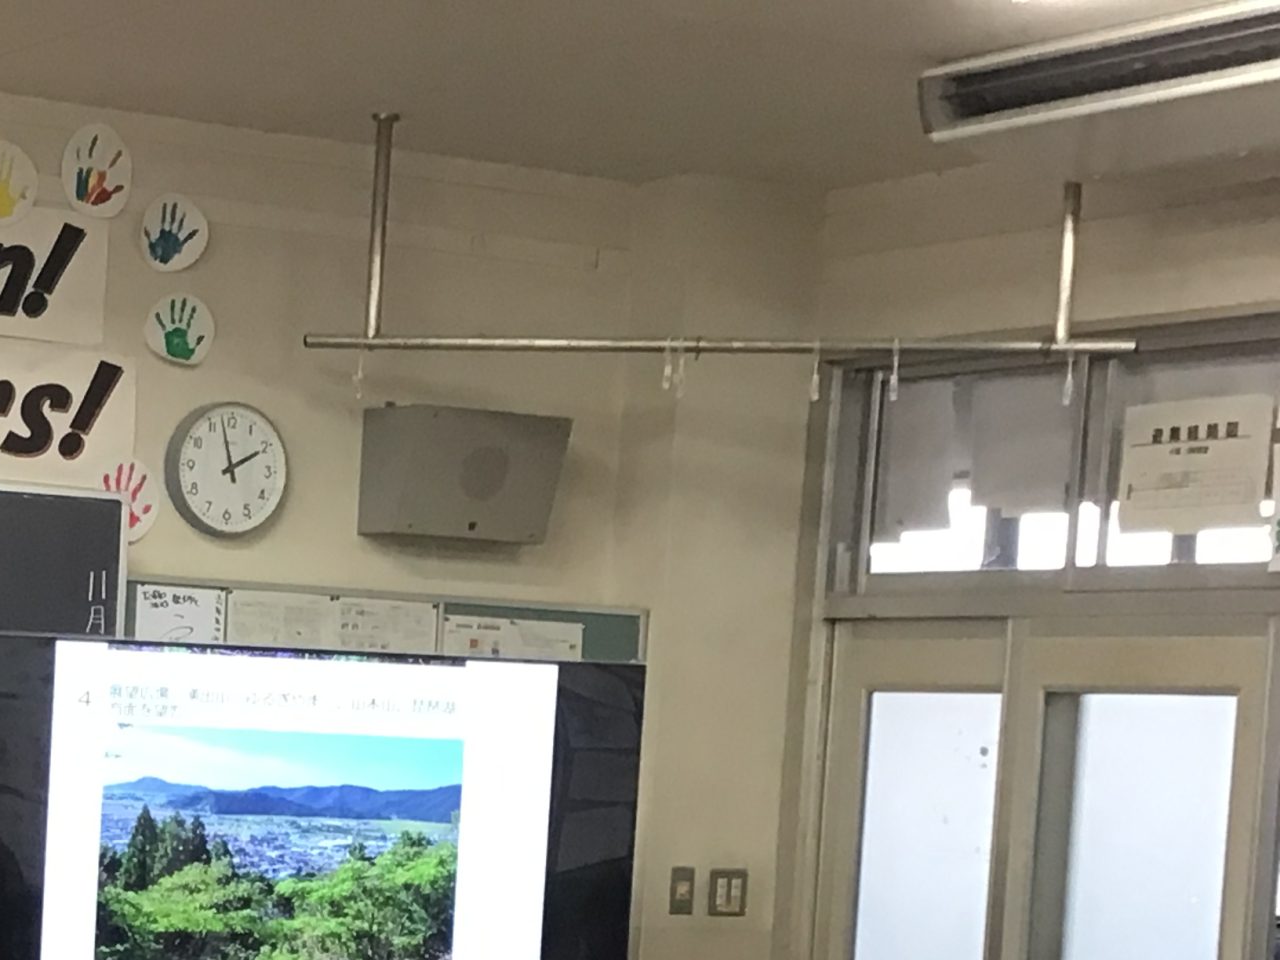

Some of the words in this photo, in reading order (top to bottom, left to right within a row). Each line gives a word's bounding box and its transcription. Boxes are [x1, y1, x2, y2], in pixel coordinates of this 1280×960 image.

[227, 416, 237, 429] 12
[193, 437, 202, 449] 10
[261, 441, 268, 454] 2
[186, 459, 195, 471] 9
[264, 465, 272, 479] 3
[190, 482, 198, 495] 8
[257, 489, 265, 500] 4
[205, 501, 212, 513] 7
[243, 503, 251, 517] 5
[222, 509, 231, 521] 6
[78, 690, 91, 707] 4
